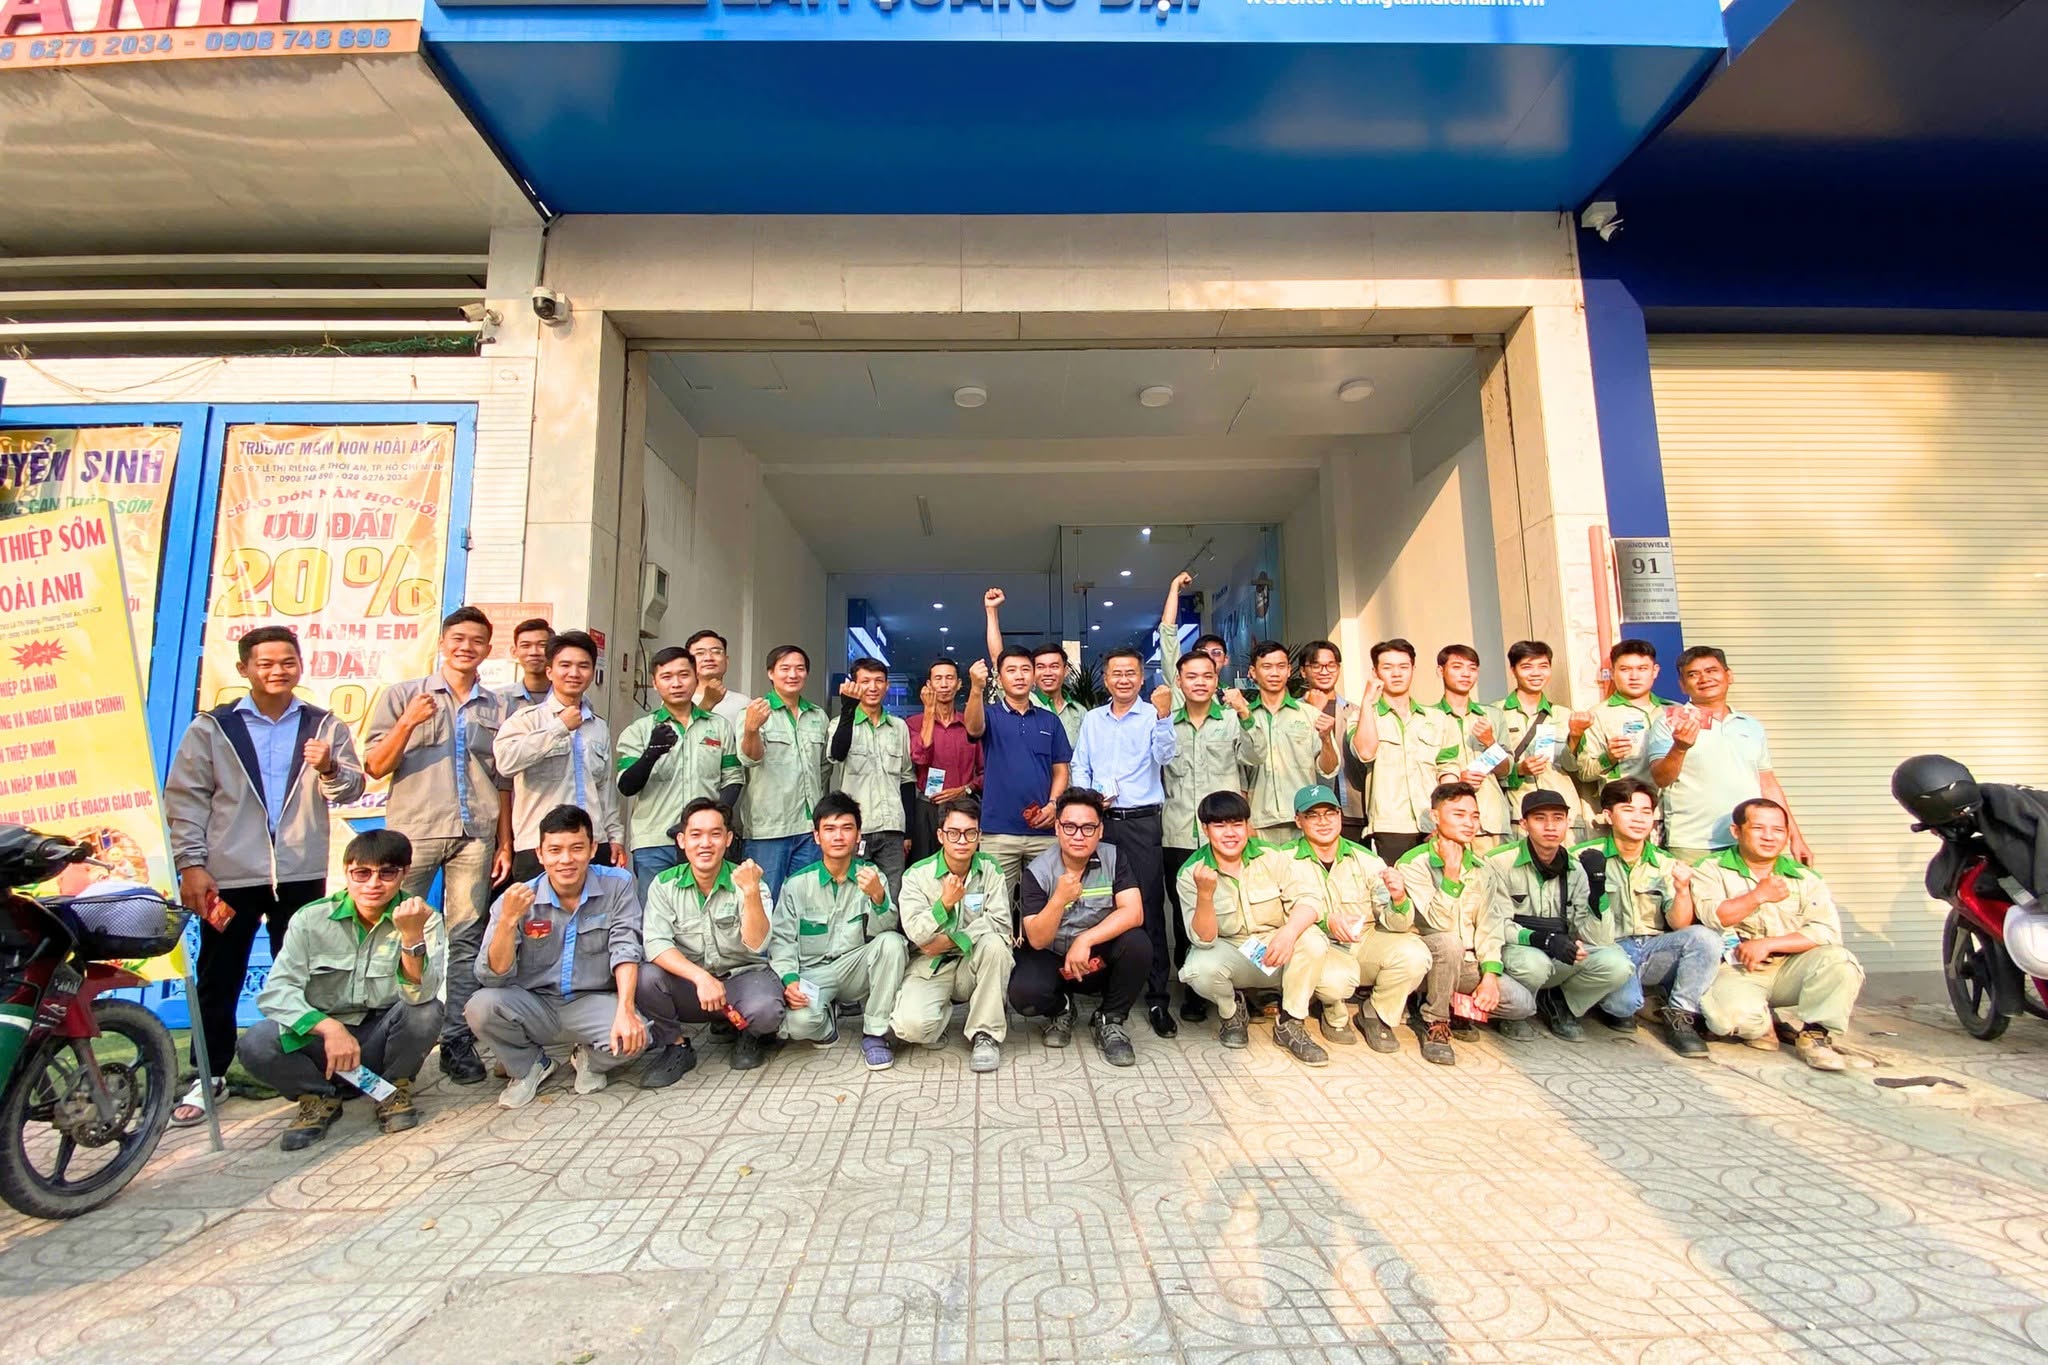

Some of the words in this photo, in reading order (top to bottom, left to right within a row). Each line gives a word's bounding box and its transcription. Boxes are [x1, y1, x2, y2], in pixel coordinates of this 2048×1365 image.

[29, 37, 96, 58] 6276
[103, 34, 173, 56] 2034
[205, 31, 274, 50] 0908
[282, 29, 332, 49] 748
[338, 28, 392, 49] 898
[337, 440, 370, 455] NON
[373, 437, 407, 455] HOÀI
[80, 449, 165, 484] SINH
[386, 473, 409, 481] 2034
[116, 496, 154, 514] SỚM
[364, 492, 404, 506] HỌC
[327, 506, 398, 541] ĐÃI
[0, 524, 53, 565] THIỆP
[58, 515, 107, 553] SỚM
[1631, 556, 1661, 575] 91
[41, 572, 84, 606] ANH
[304, 623, 366, 641] ANH
[376, 623, 418, 640] EM
[33, 673, 58, 693] NHÂN
[14, 711, 26, 729] VÀ
[26, 706, 53, 727] NGOÀI
[70, 699, 95, 719] HÀNH
[30, 739, 57, 758] NHÓM
[58, 769, 78, 786] NON
[112, 790, 134, 811] GIÁO
[134, 789, 154, 810] DỤC
